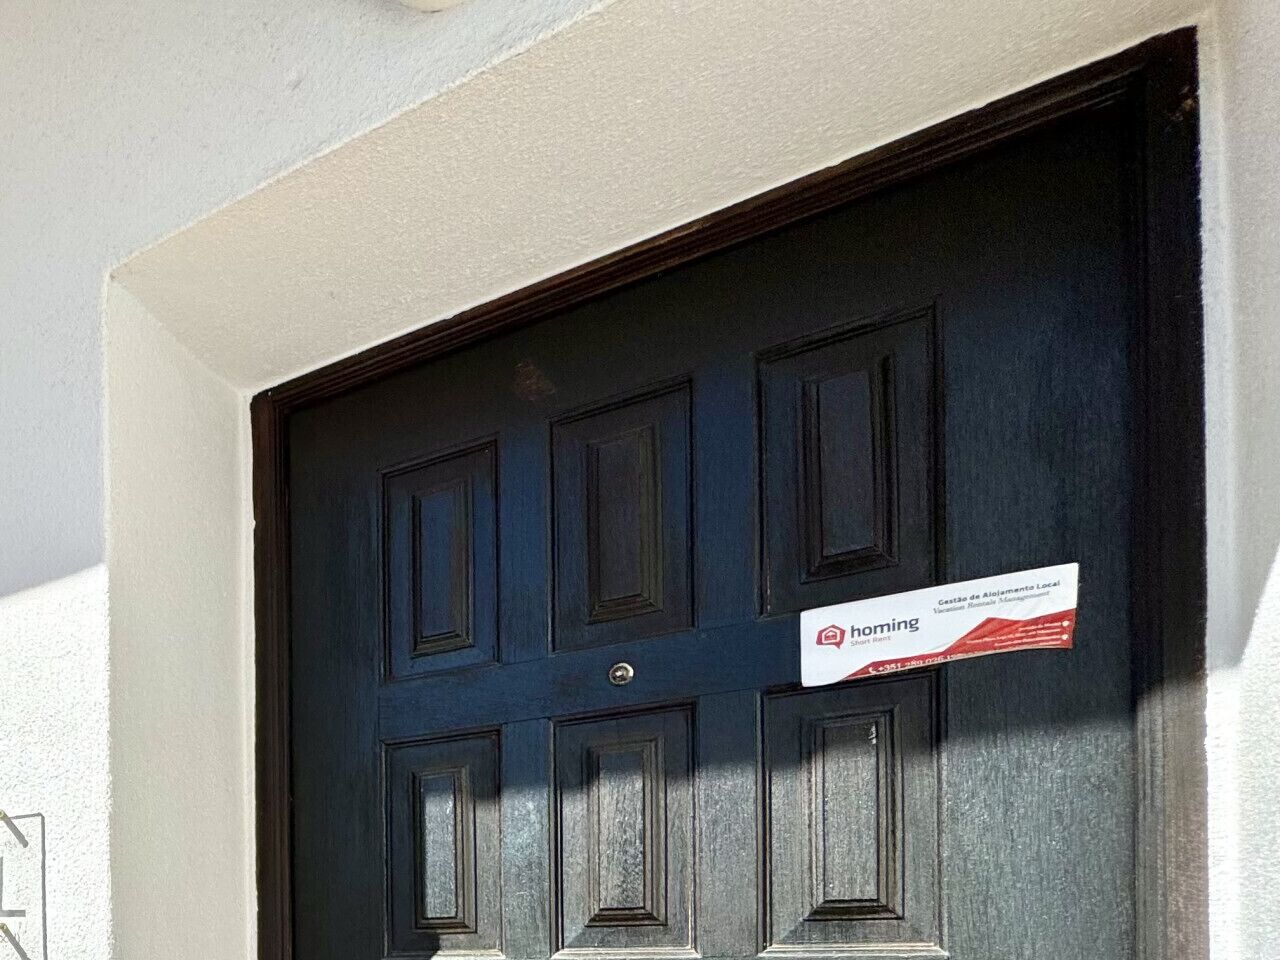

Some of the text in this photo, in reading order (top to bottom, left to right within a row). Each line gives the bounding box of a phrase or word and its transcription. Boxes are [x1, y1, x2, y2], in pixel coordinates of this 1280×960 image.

[938, 597, 967, 606] Gestão
[983, 585, 1034, 598] Alojamento
[1037, 580, 1061, 590] Local
[850, 618, 919, 638] homing
[850, 635, 891, 647] Short Rent
[879, 663, 901, 672] +351
